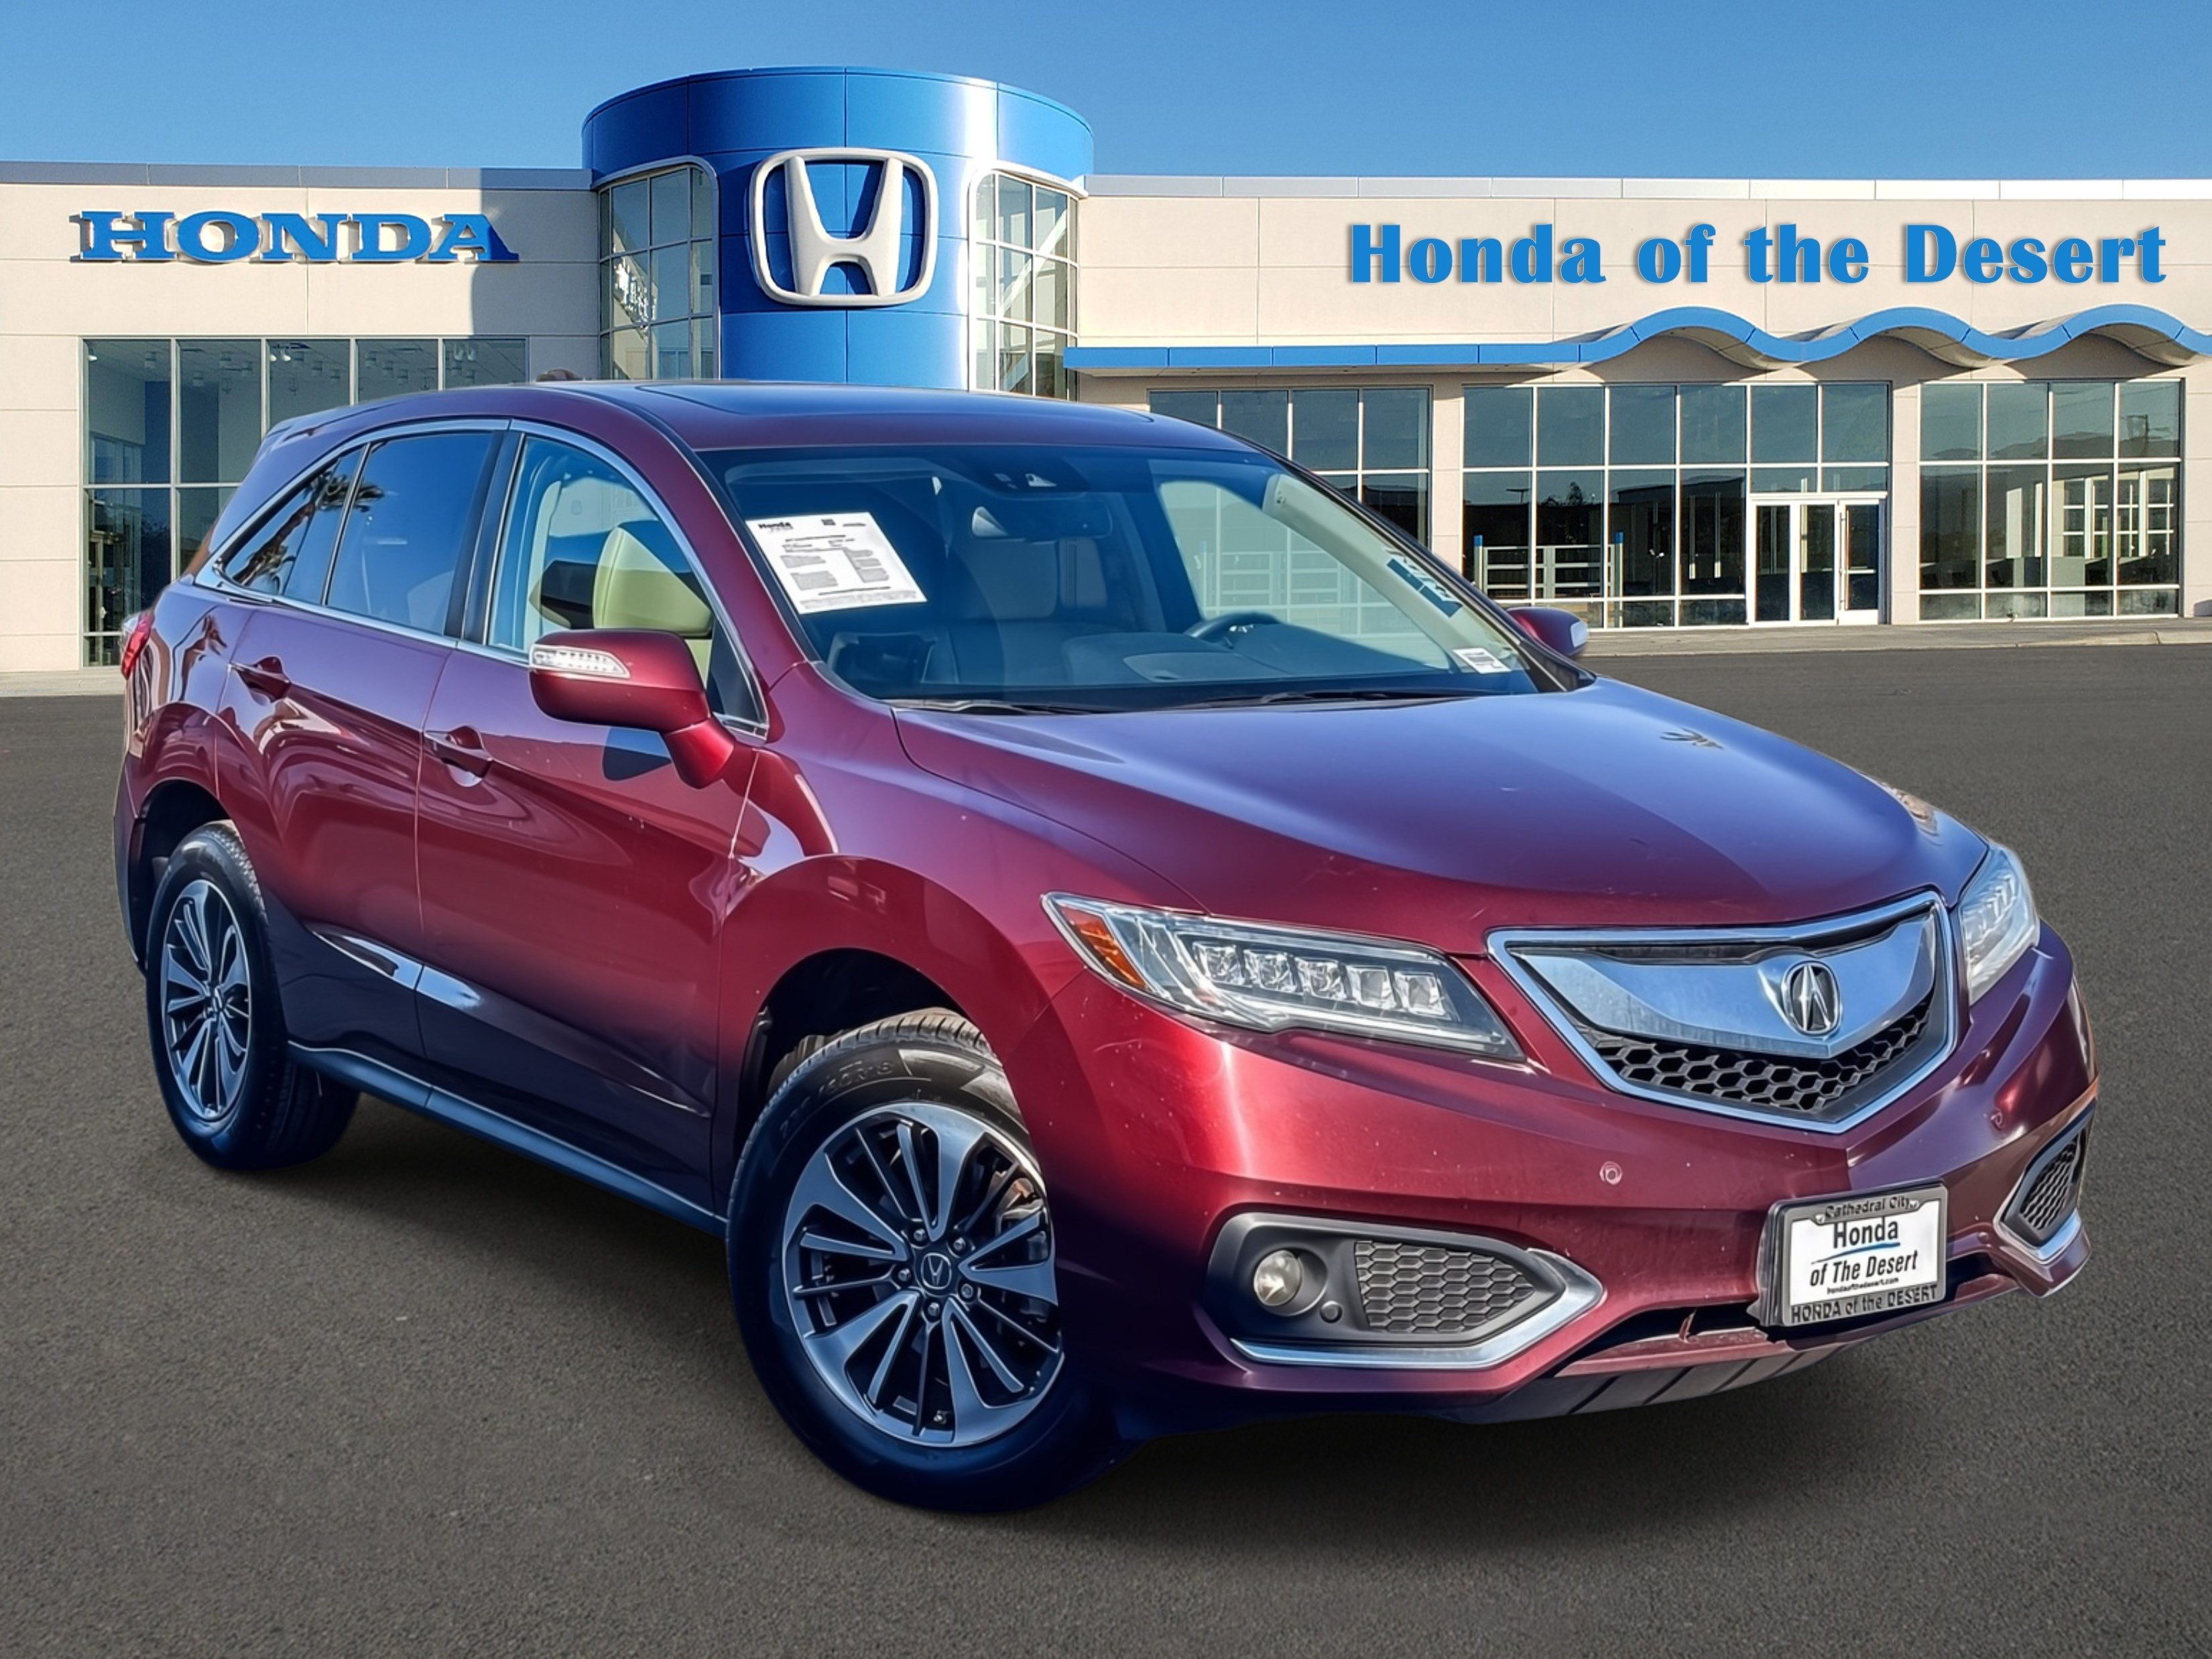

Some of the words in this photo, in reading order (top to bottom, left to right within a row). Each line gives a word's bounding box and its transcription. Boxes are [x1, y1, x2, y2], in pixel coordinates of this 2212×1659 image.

[78, 210, 519, 263] HONDA
[1351, 223, 1607, 284] Honda
[1638, 223, 1717, 284] of
[1743, 223, 1869, 284] the
[1905, 223, 2167, 284] Desert
[1825, 1198, 1885, 1218] Cathedral
[1889, 1195, 1910, 1211] City
[1833, 1216, 1899, 1249] Honda
[1810, 1262, 1828, 1287] of
[1833, 1259, 1861, 1284] The
[1865, 1249, 1918, 1279] Desert
[1791, 1300, 1842, 1325] HONDA
[1845, 1299, 1858, 1316] of
[1862, 1295, 1882, 1312] the
[1887, 1284, 1938, 1307] DESERT
